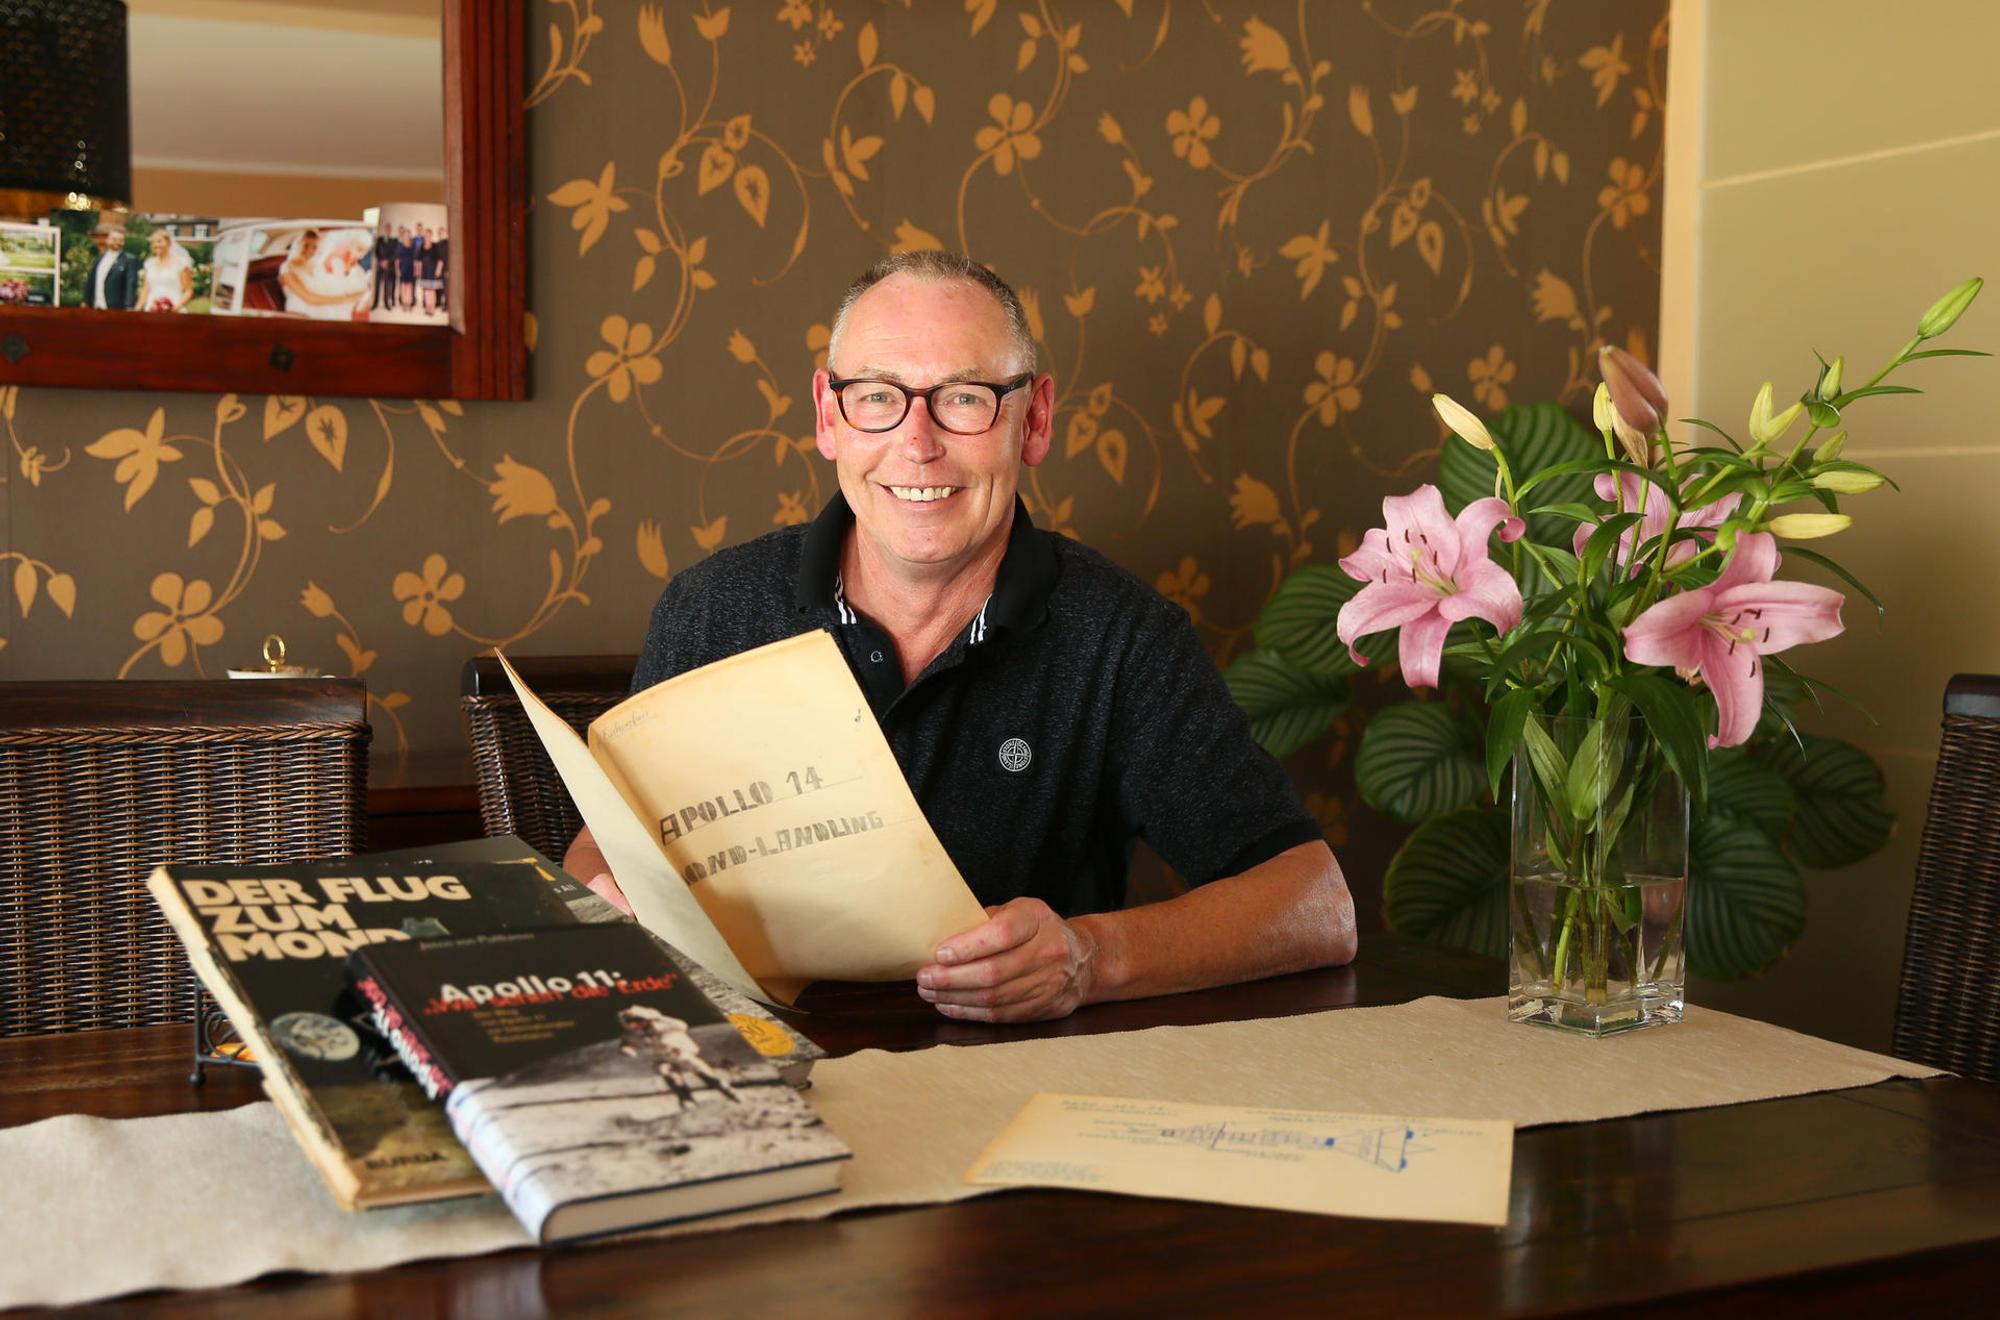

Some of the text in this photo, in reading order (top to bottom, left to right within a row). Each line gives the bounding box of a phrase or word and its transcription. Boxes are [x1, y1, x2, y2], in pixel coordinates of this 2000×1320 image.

[659, 766, 823, 846] APOLLO 14
[681, 811, 884, 886] OND-LANDUNG
[181, 875, 472, 906] DER FLUG
[198, 903, 358, 934] ZUM
[441, 974, 572, 1005] Apollo
